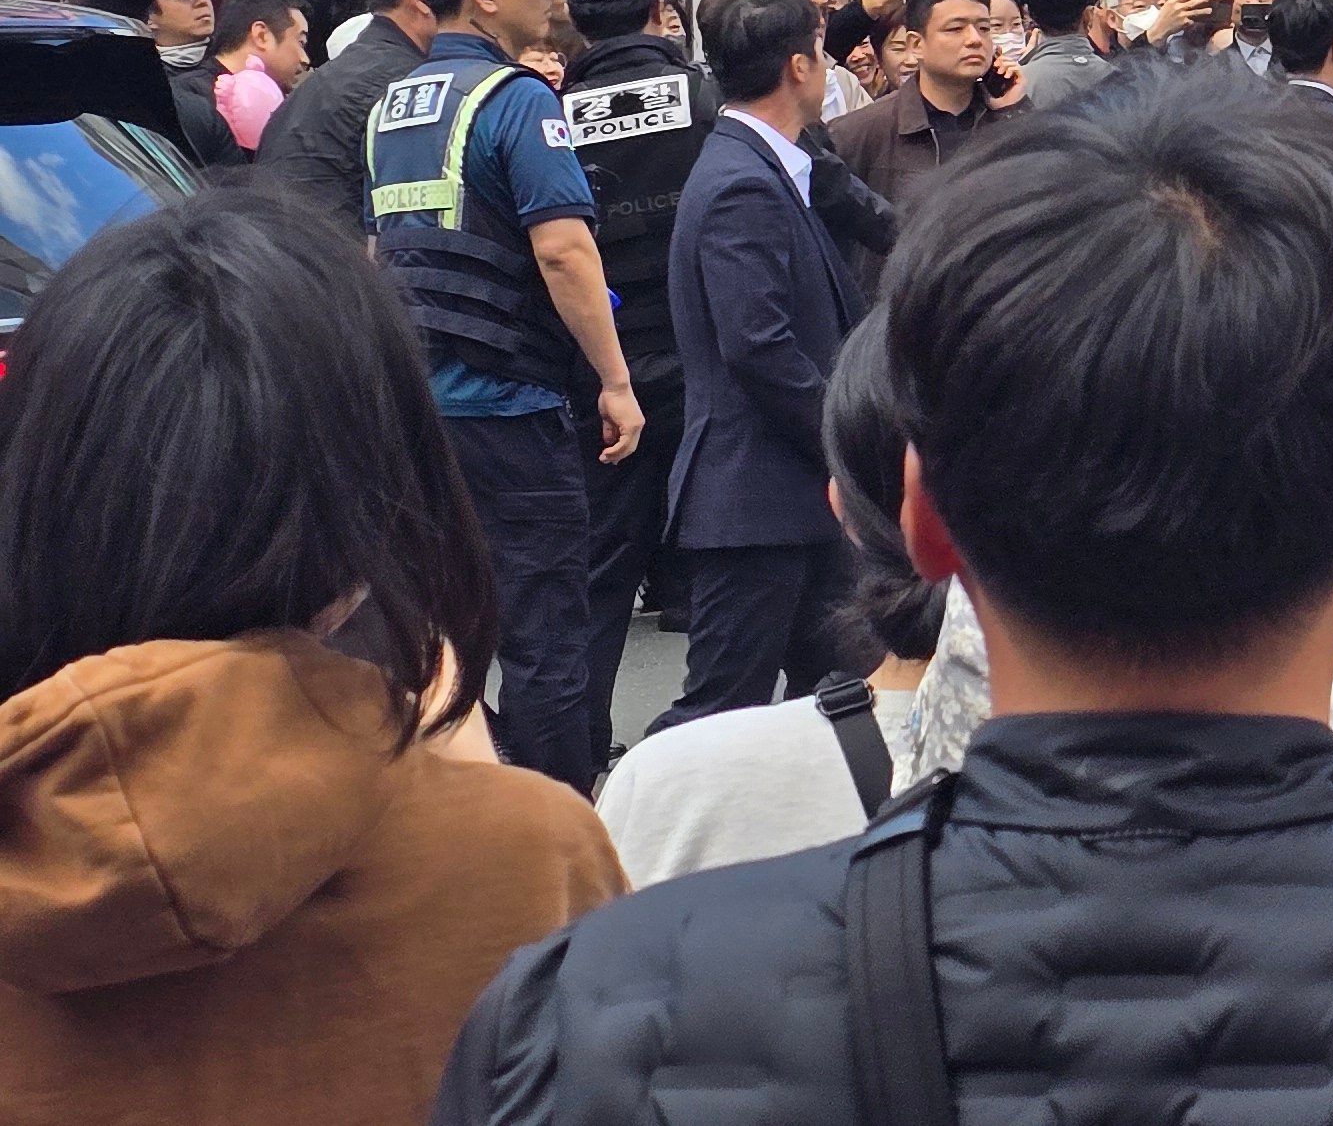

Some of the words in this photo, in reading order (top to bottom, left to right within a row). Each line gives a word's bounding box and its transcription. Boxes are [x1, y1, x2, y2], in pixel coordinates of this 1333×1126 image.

[390, 82, 436, 120] 경찰
[580, 82, 676, 121] 경찰
[582, 111, 676, 139] POLICE
[379, 185, 428, 209] POLICE
